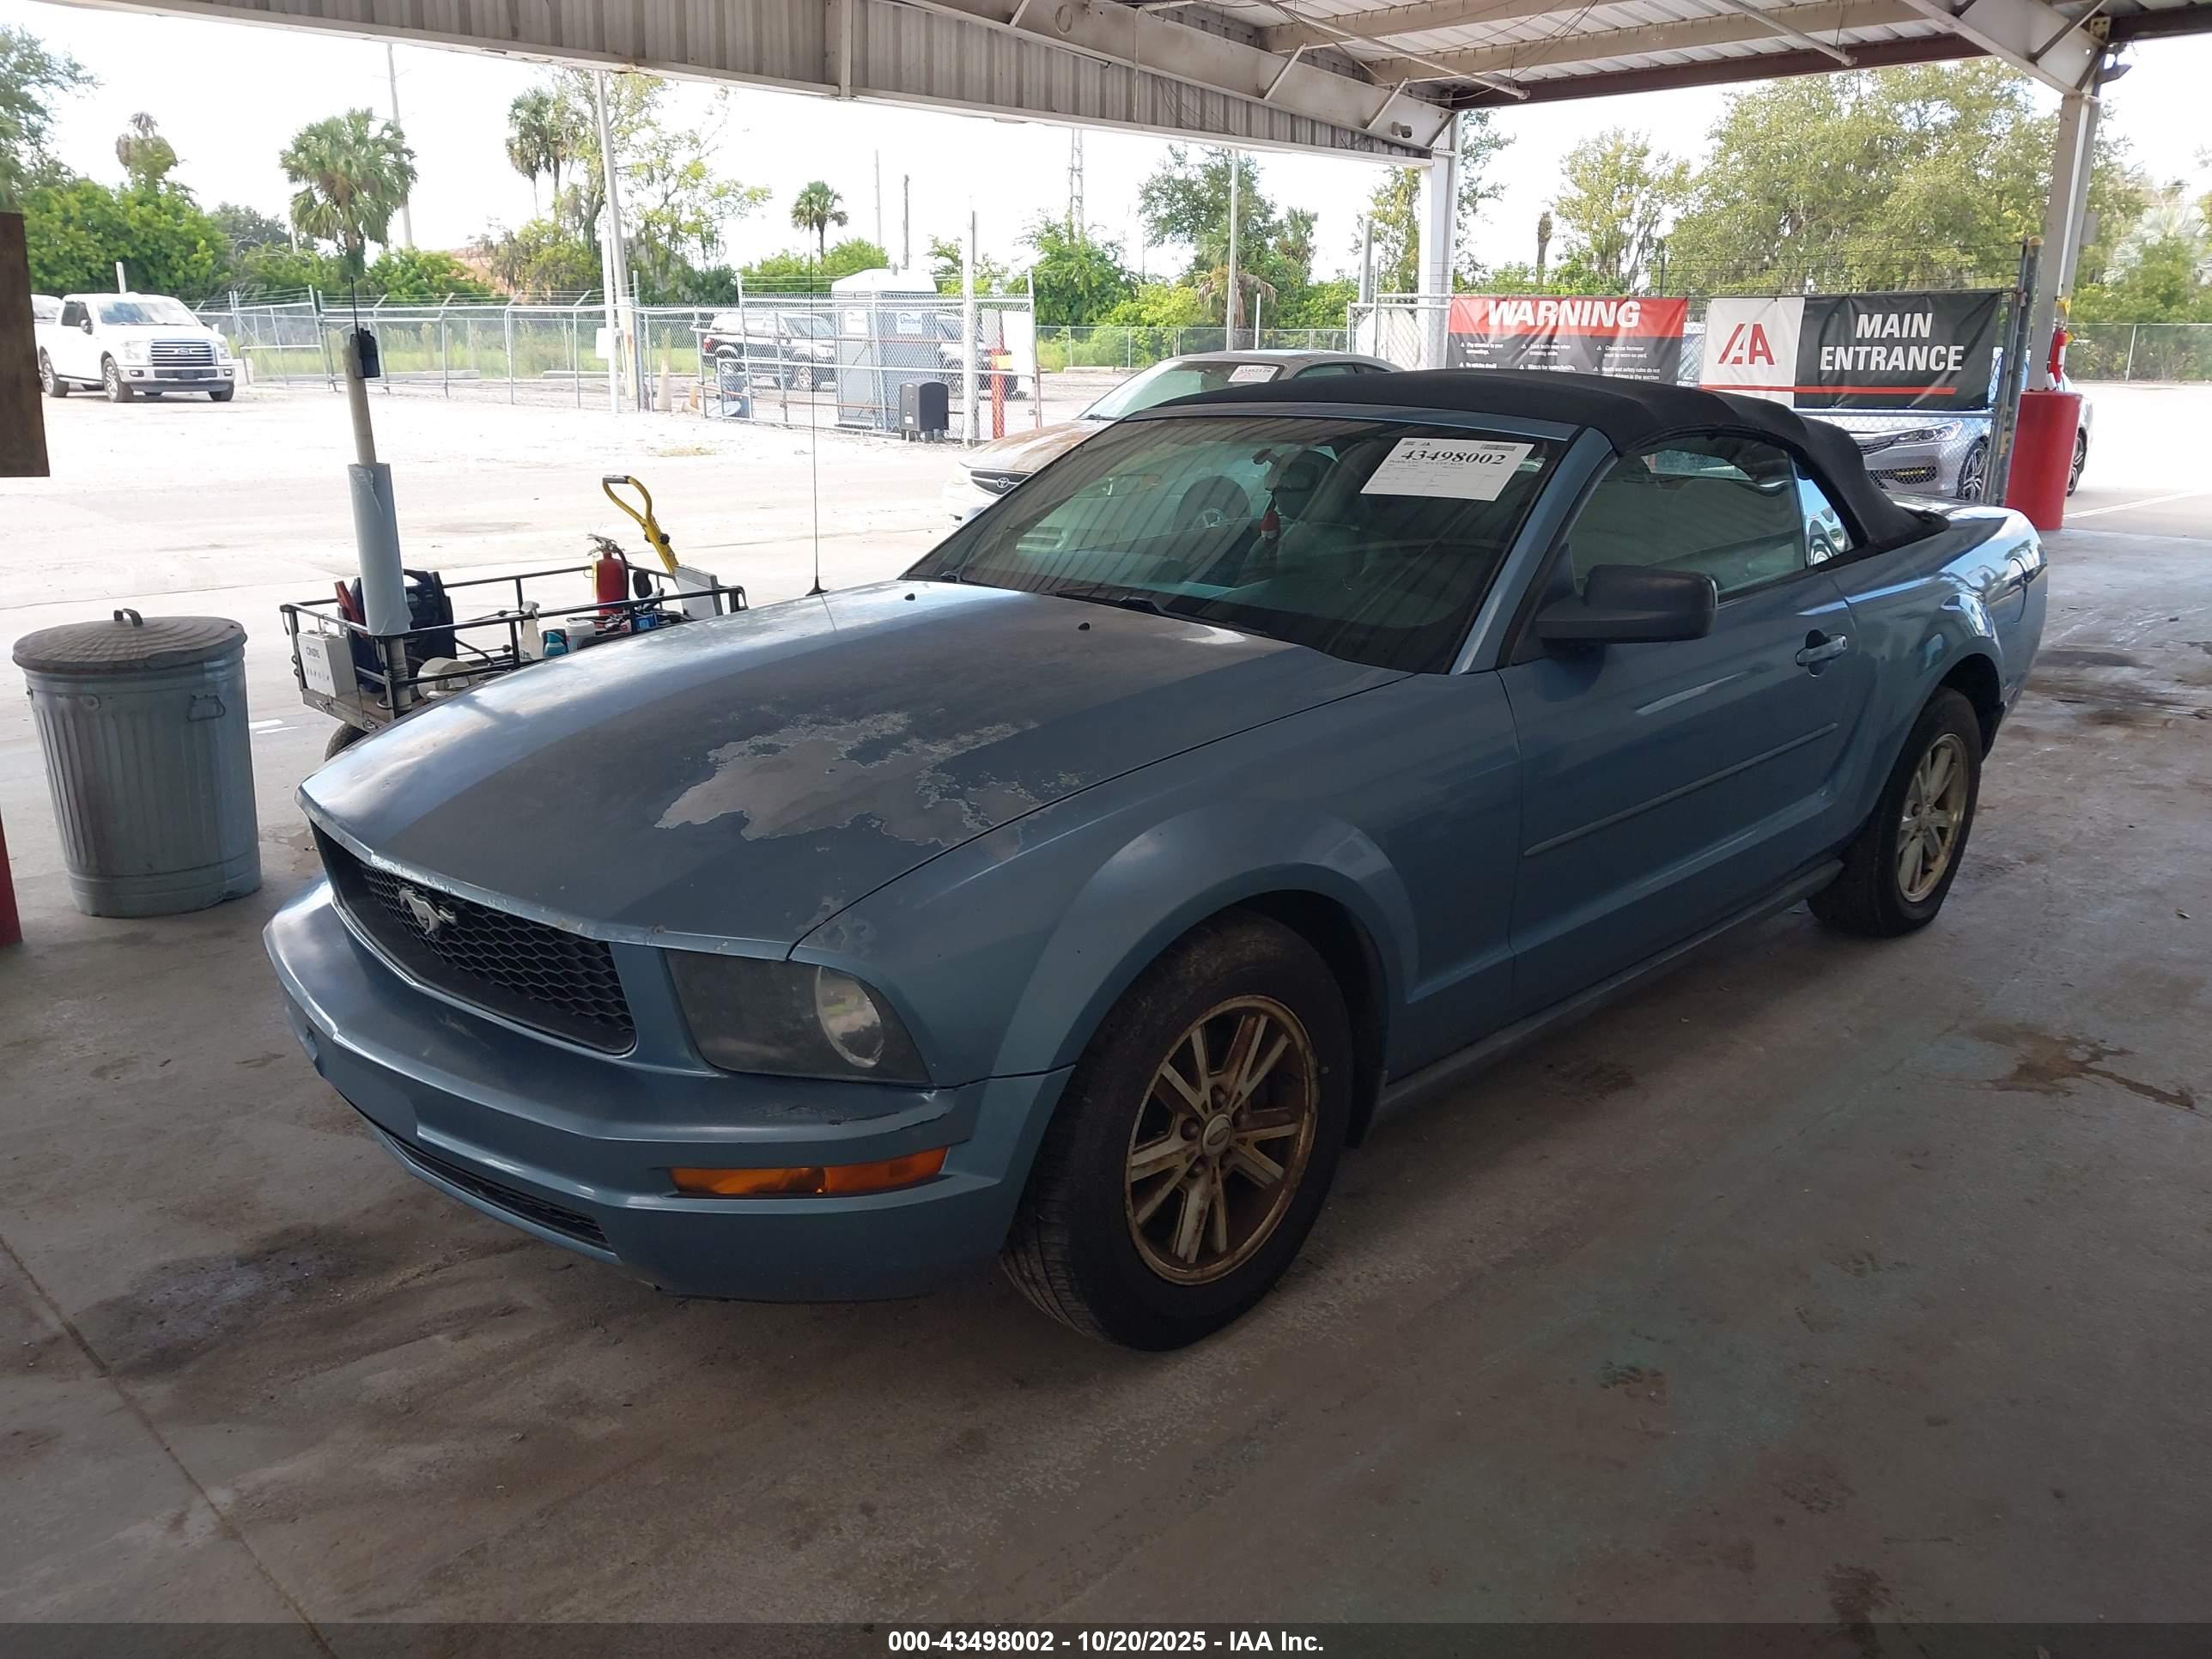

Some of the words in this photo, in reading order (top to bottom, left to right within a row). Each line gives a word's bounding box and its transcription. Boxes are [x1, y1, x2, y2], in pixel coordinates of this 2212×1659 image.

[1487, 301, 1641, 328] WARNING
[1856, 313, 1933, 338] MAIN
[1820, 346, 1965, 371] ENTRANCE
[1401, 450, 1506, 465] 43498002
